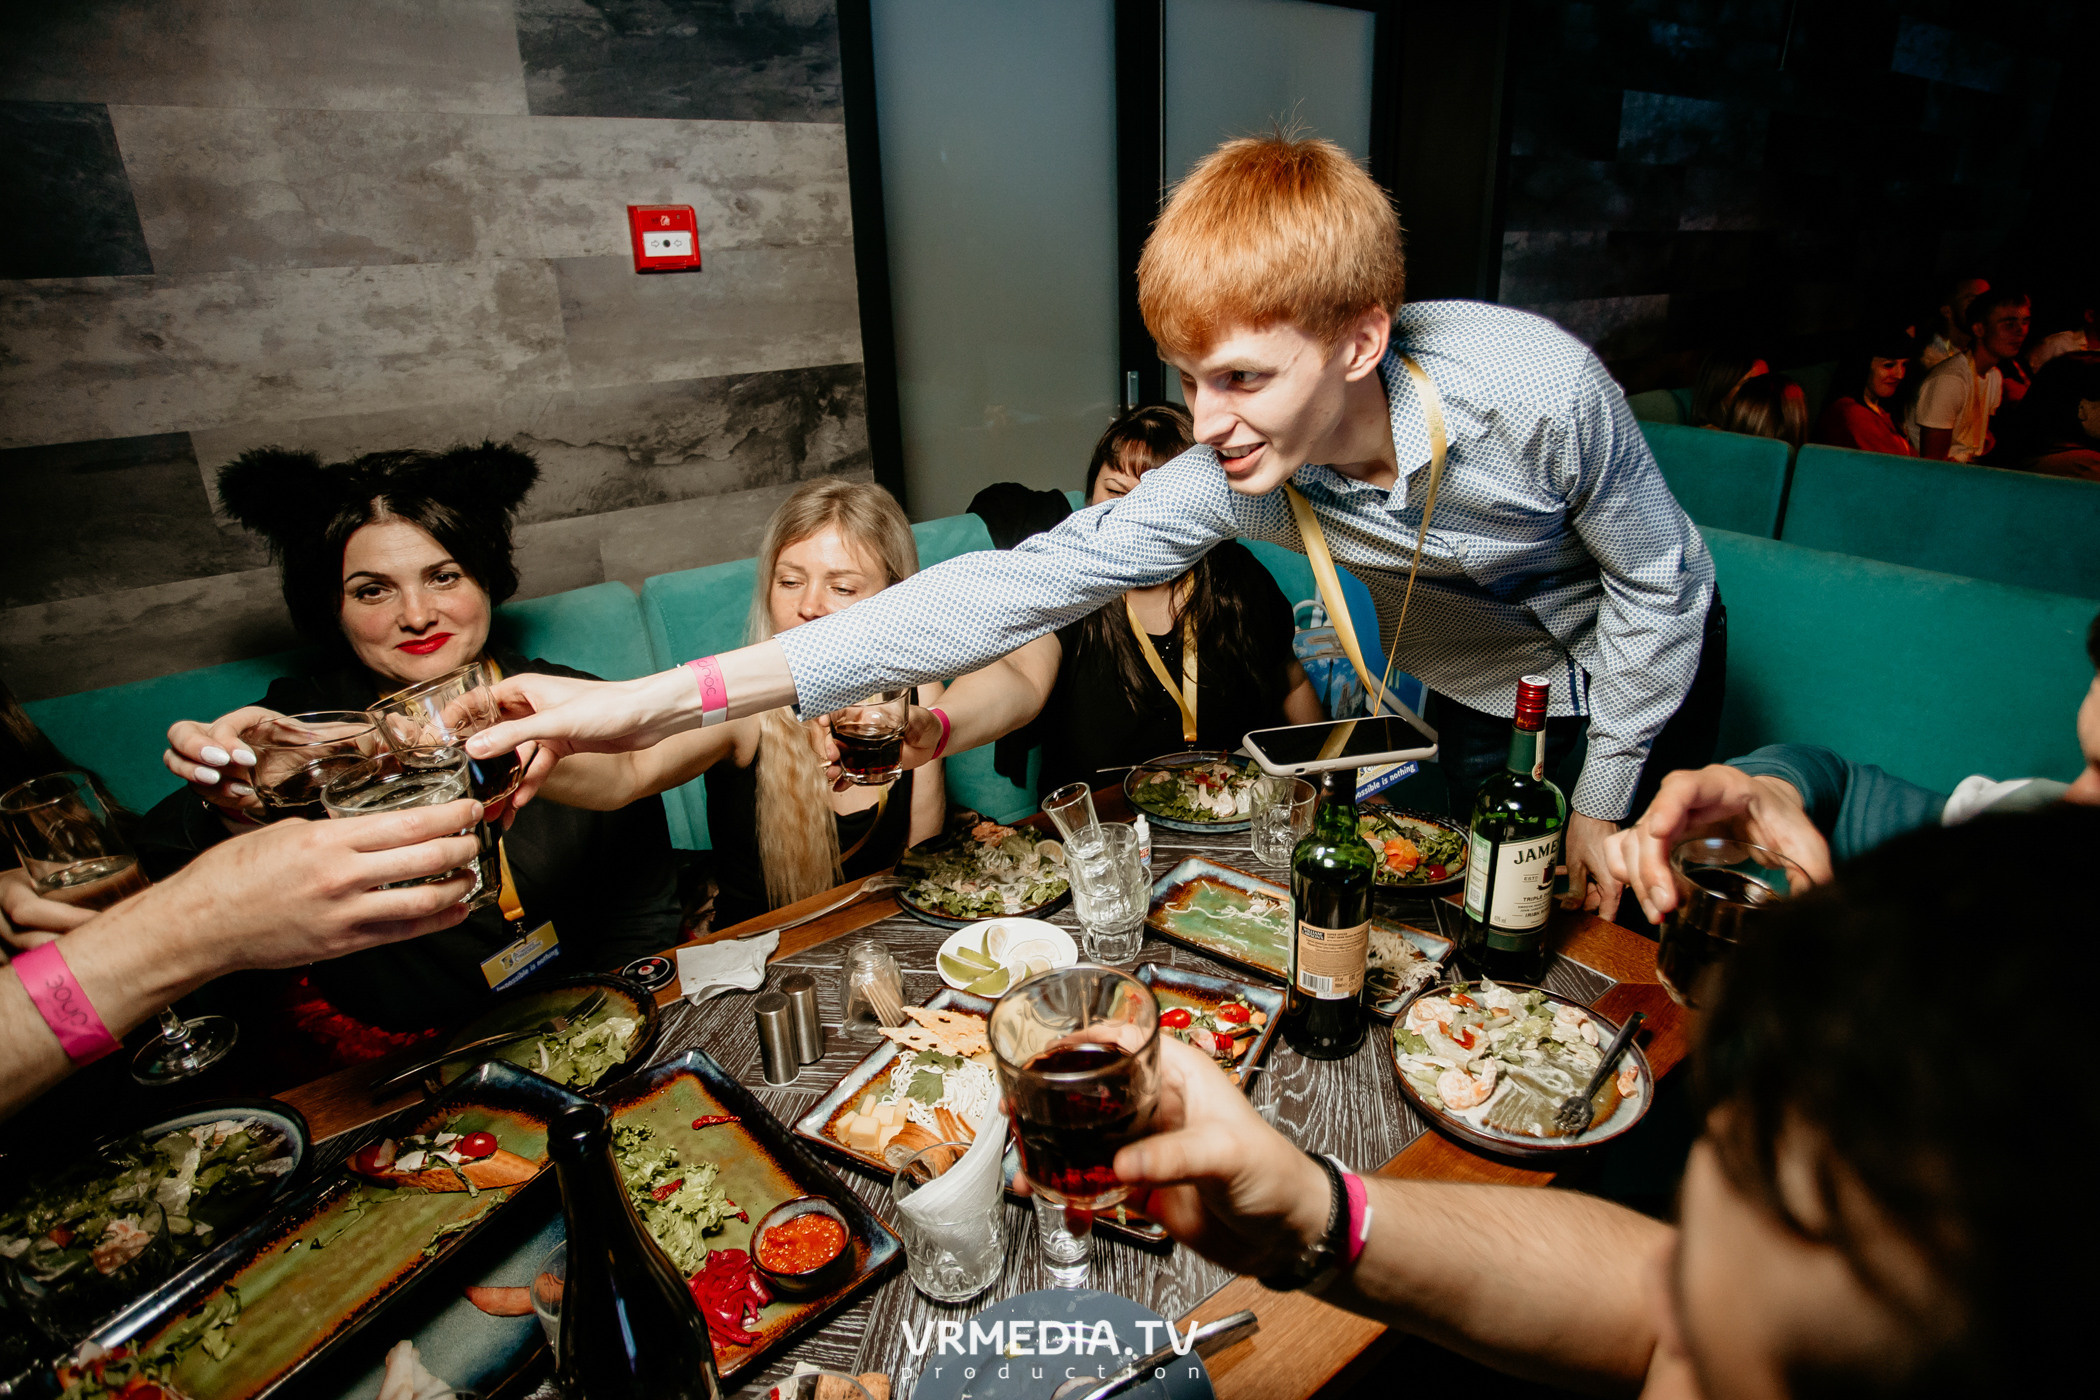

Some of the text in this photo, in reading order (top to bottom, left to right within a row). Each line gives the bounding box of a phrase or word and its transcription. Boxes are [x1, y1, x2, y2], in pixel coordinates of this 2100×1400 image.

[1381, 777, 1389, 786] is
[1389, 763, 1416, 782] nothing
[1513, 839, 1560, 865] JAME
